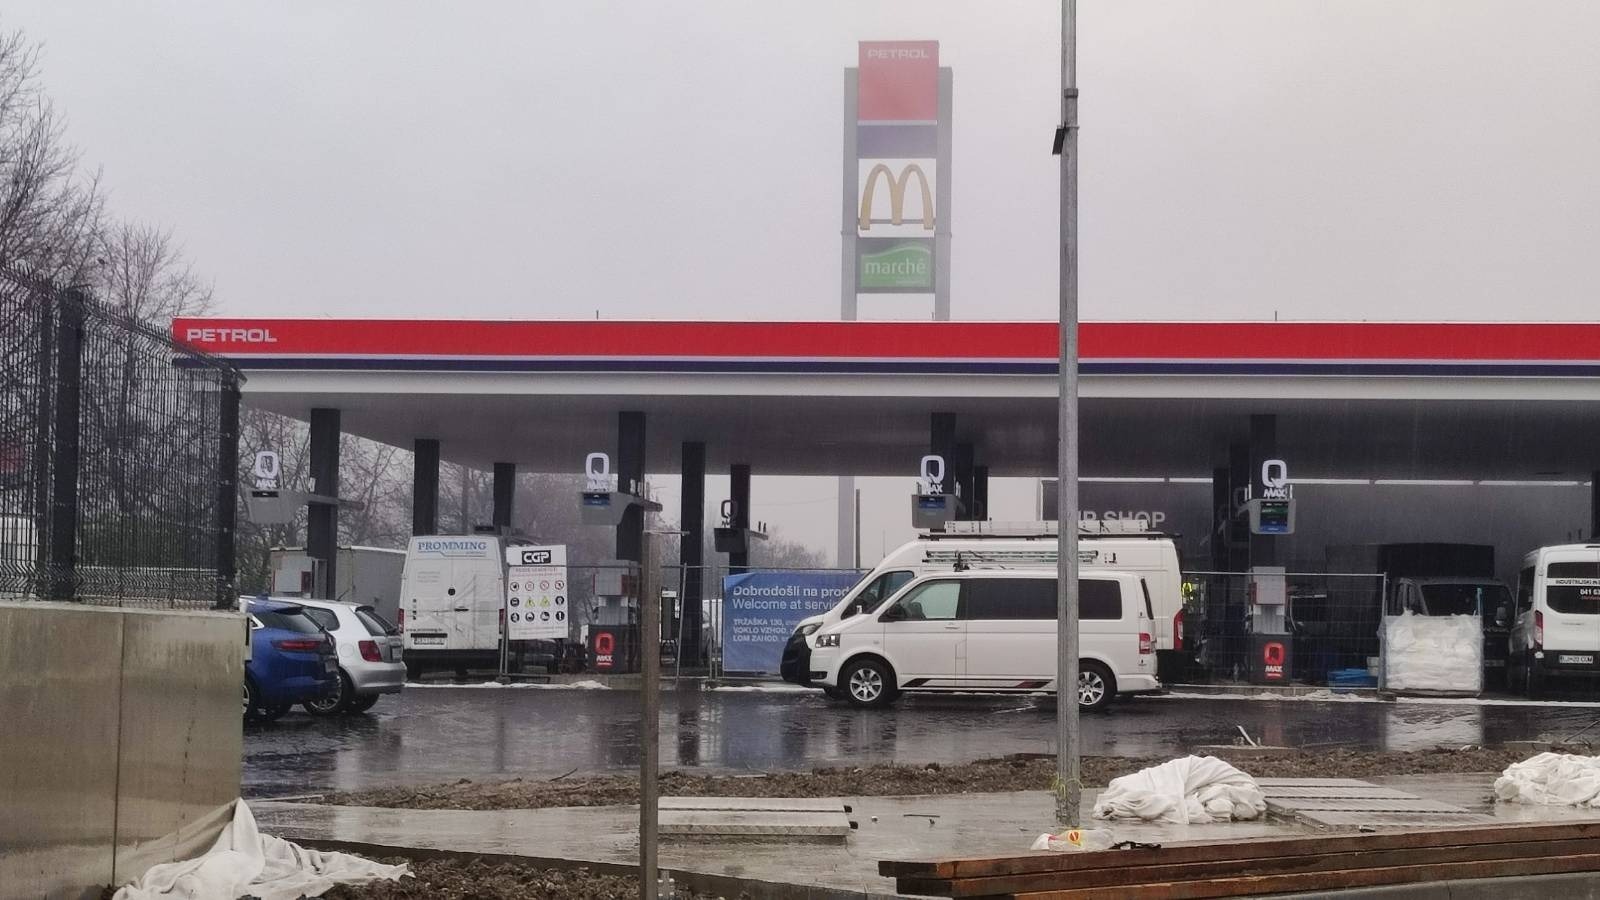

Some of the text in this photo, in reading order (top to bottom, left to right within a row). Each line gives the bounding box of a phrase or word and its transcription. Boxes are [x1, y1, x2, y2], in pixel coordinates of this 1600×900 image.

[864, 258, 926, 274] marché
[186, 328, 278, 343] PETROL
[585, 452, 610, 482] Q
[921, 455, 945, 484] Q
[1262, 459, 1287, 488] Q
[418, 541, 487, 551] PROMMING
[733, 585, 800, 596] Dobrodošli
[803, 588, 817, 597] na
[732, 598, 787, 610] Welcome
[789, 600, 802, 610] at
